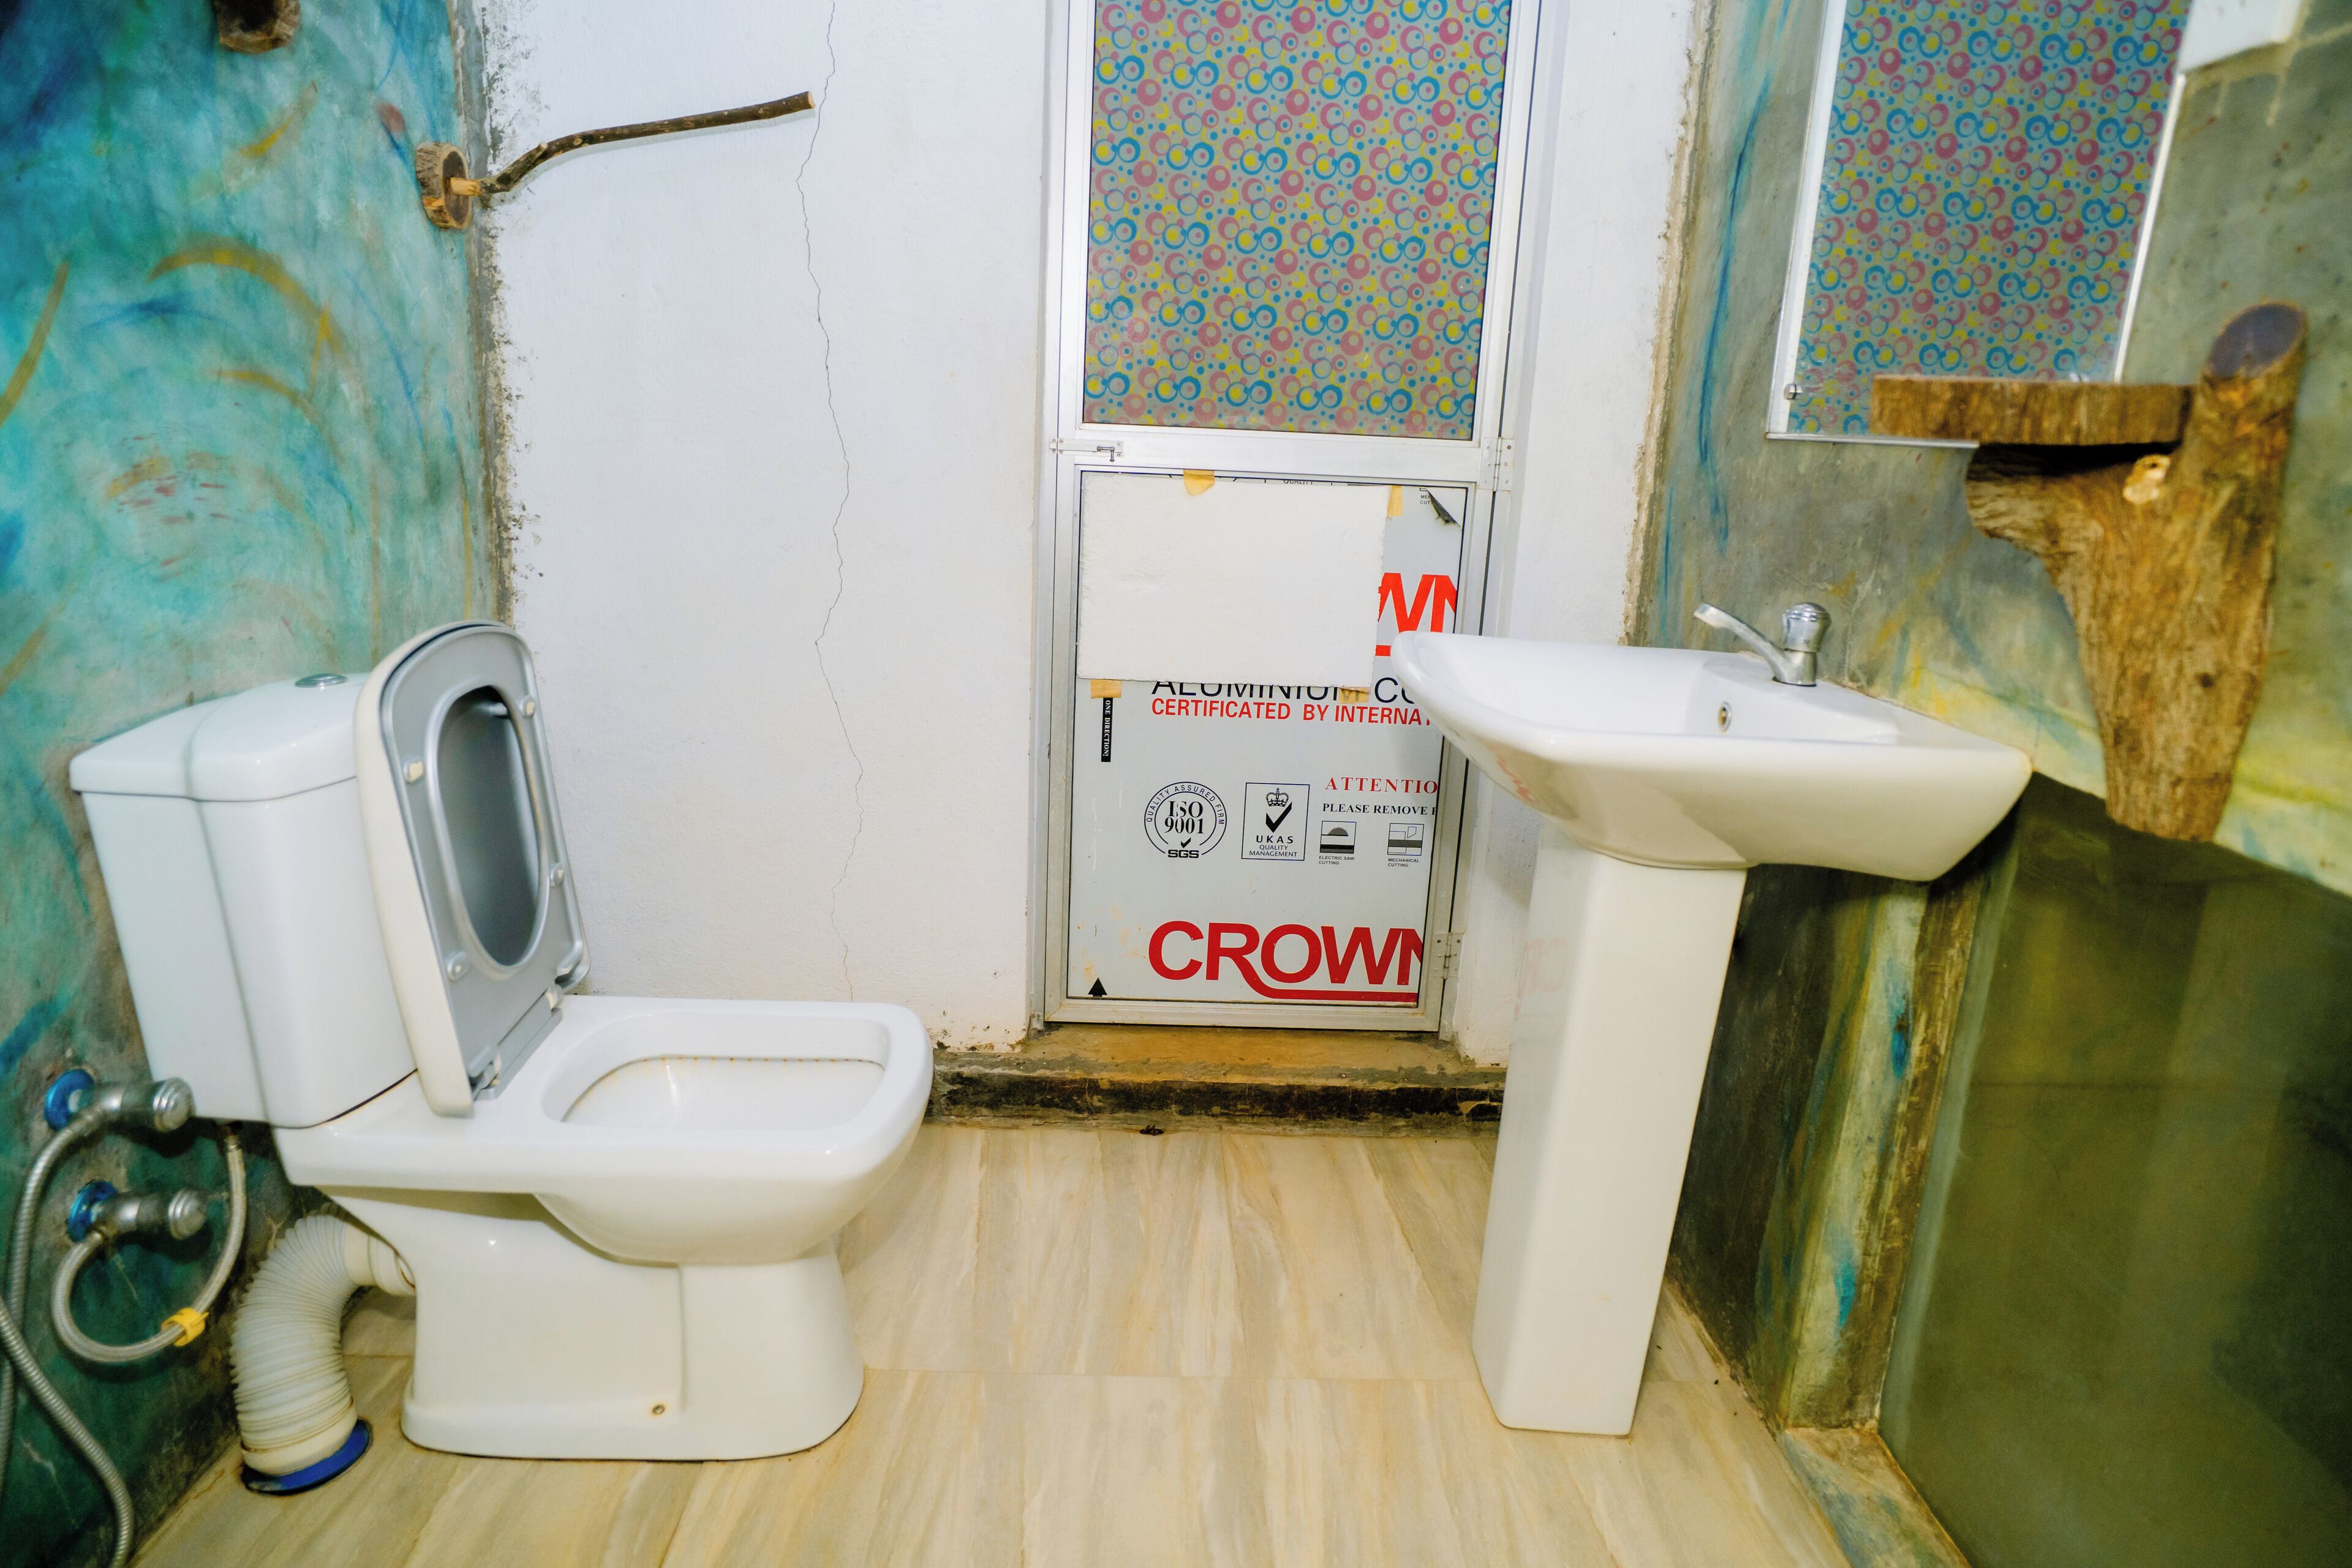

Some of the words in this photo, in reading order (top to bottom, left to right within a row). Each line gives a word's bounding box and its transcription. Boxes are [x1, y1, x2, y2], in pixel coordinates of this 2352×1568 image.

[1152, 698, 1291, 720] CERTIFICATED
[1303, 704, 1329, 721] BY
[1335, 705, 1430, 726] INTERNA
[1146, 789, 1170, 823] QUALITY
[1174, 785, 1216, 802] ASSURED
[1215, 804, 1225, 824] FIRM
[1168, 801, 1204, 818] ISO
[1322, 803, 1370, 813] PLEASE
[1373, 805, 1428, 815] REMOVE
[1164, 816, 1205, 834] 9001
[1256, 835, 1294, 844] UKAS
[1167, 849, 1199, 859] SGS
